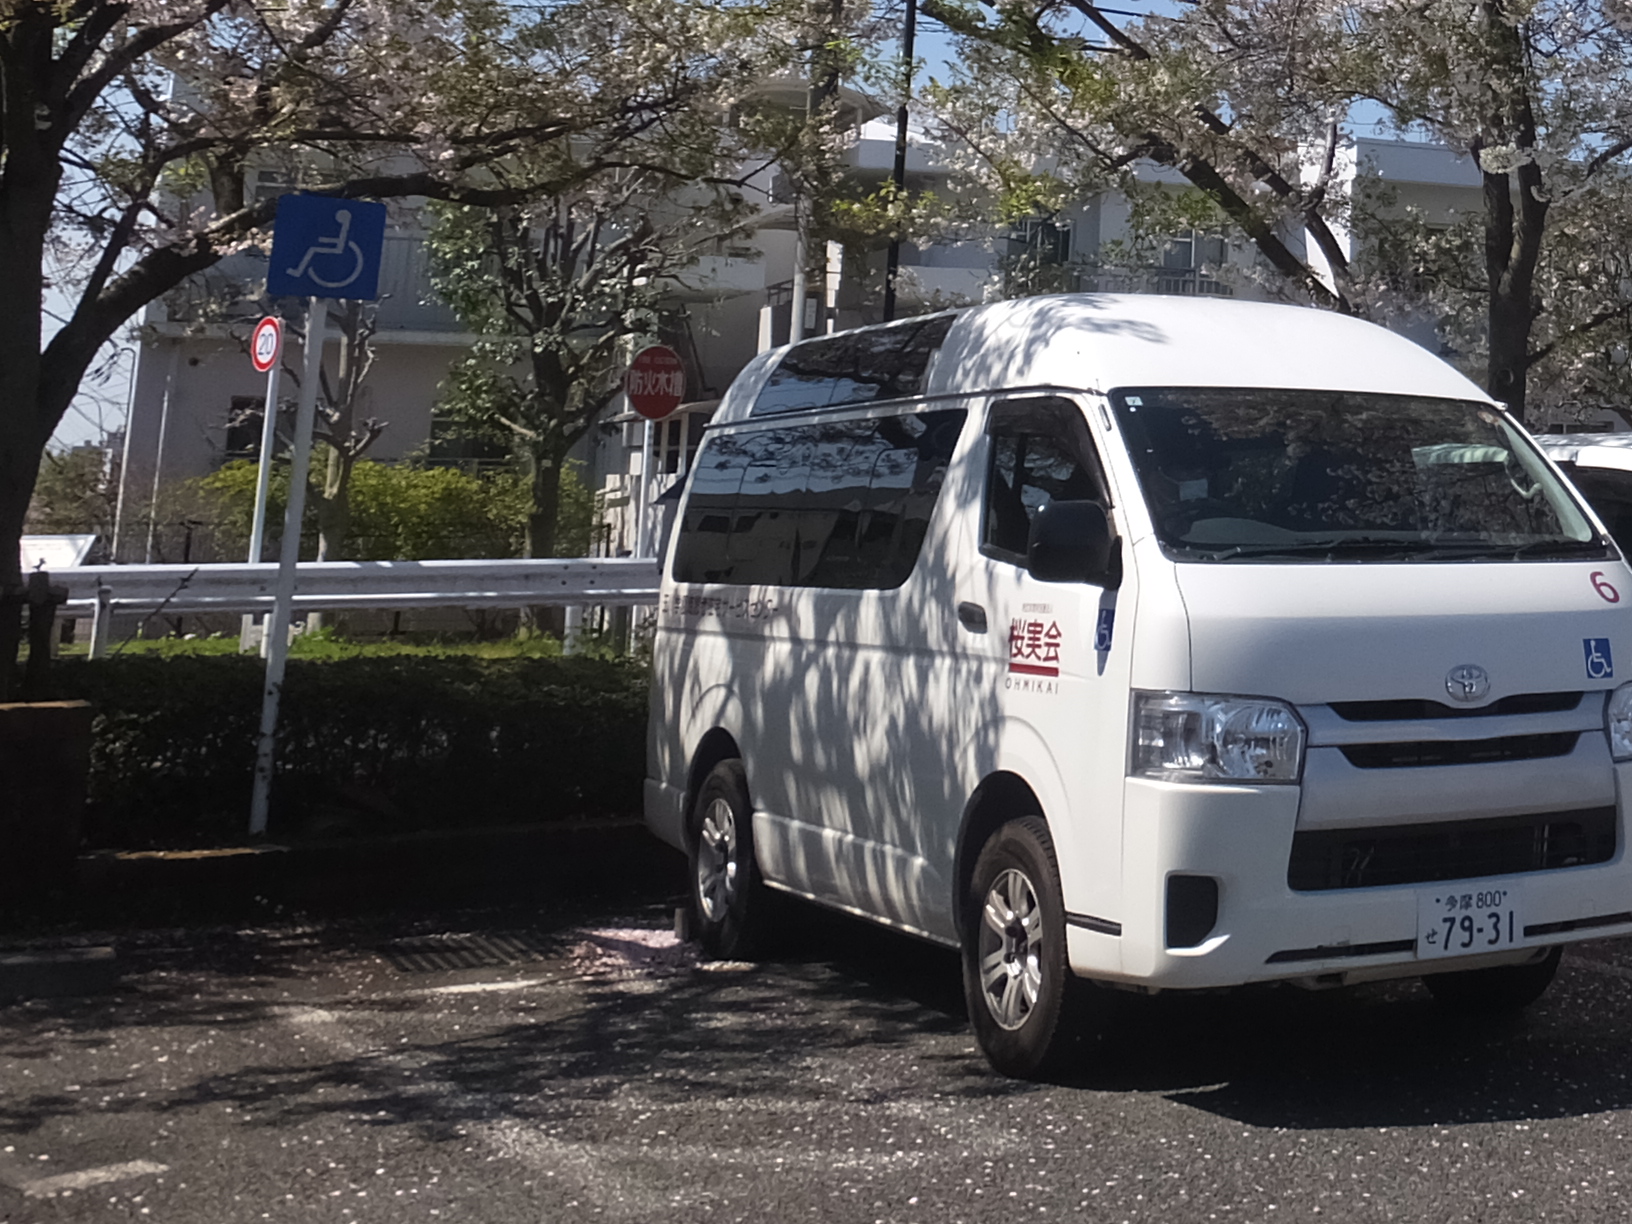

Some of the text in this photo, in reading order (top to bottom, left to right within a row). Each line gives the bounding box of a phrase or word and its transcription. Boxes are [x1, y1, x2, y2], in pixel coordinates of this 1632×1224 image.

[258, 332, 274, 356] 20
[1590, 571, 1620, 603] 6
[1008, 618, 1062, 663] 桜実会
[1005, 677, 1059, 694] OHMIKAI
[1476, 890, 1501, 909] 800
[1426, 910, 1514, 951] せ 79-31
